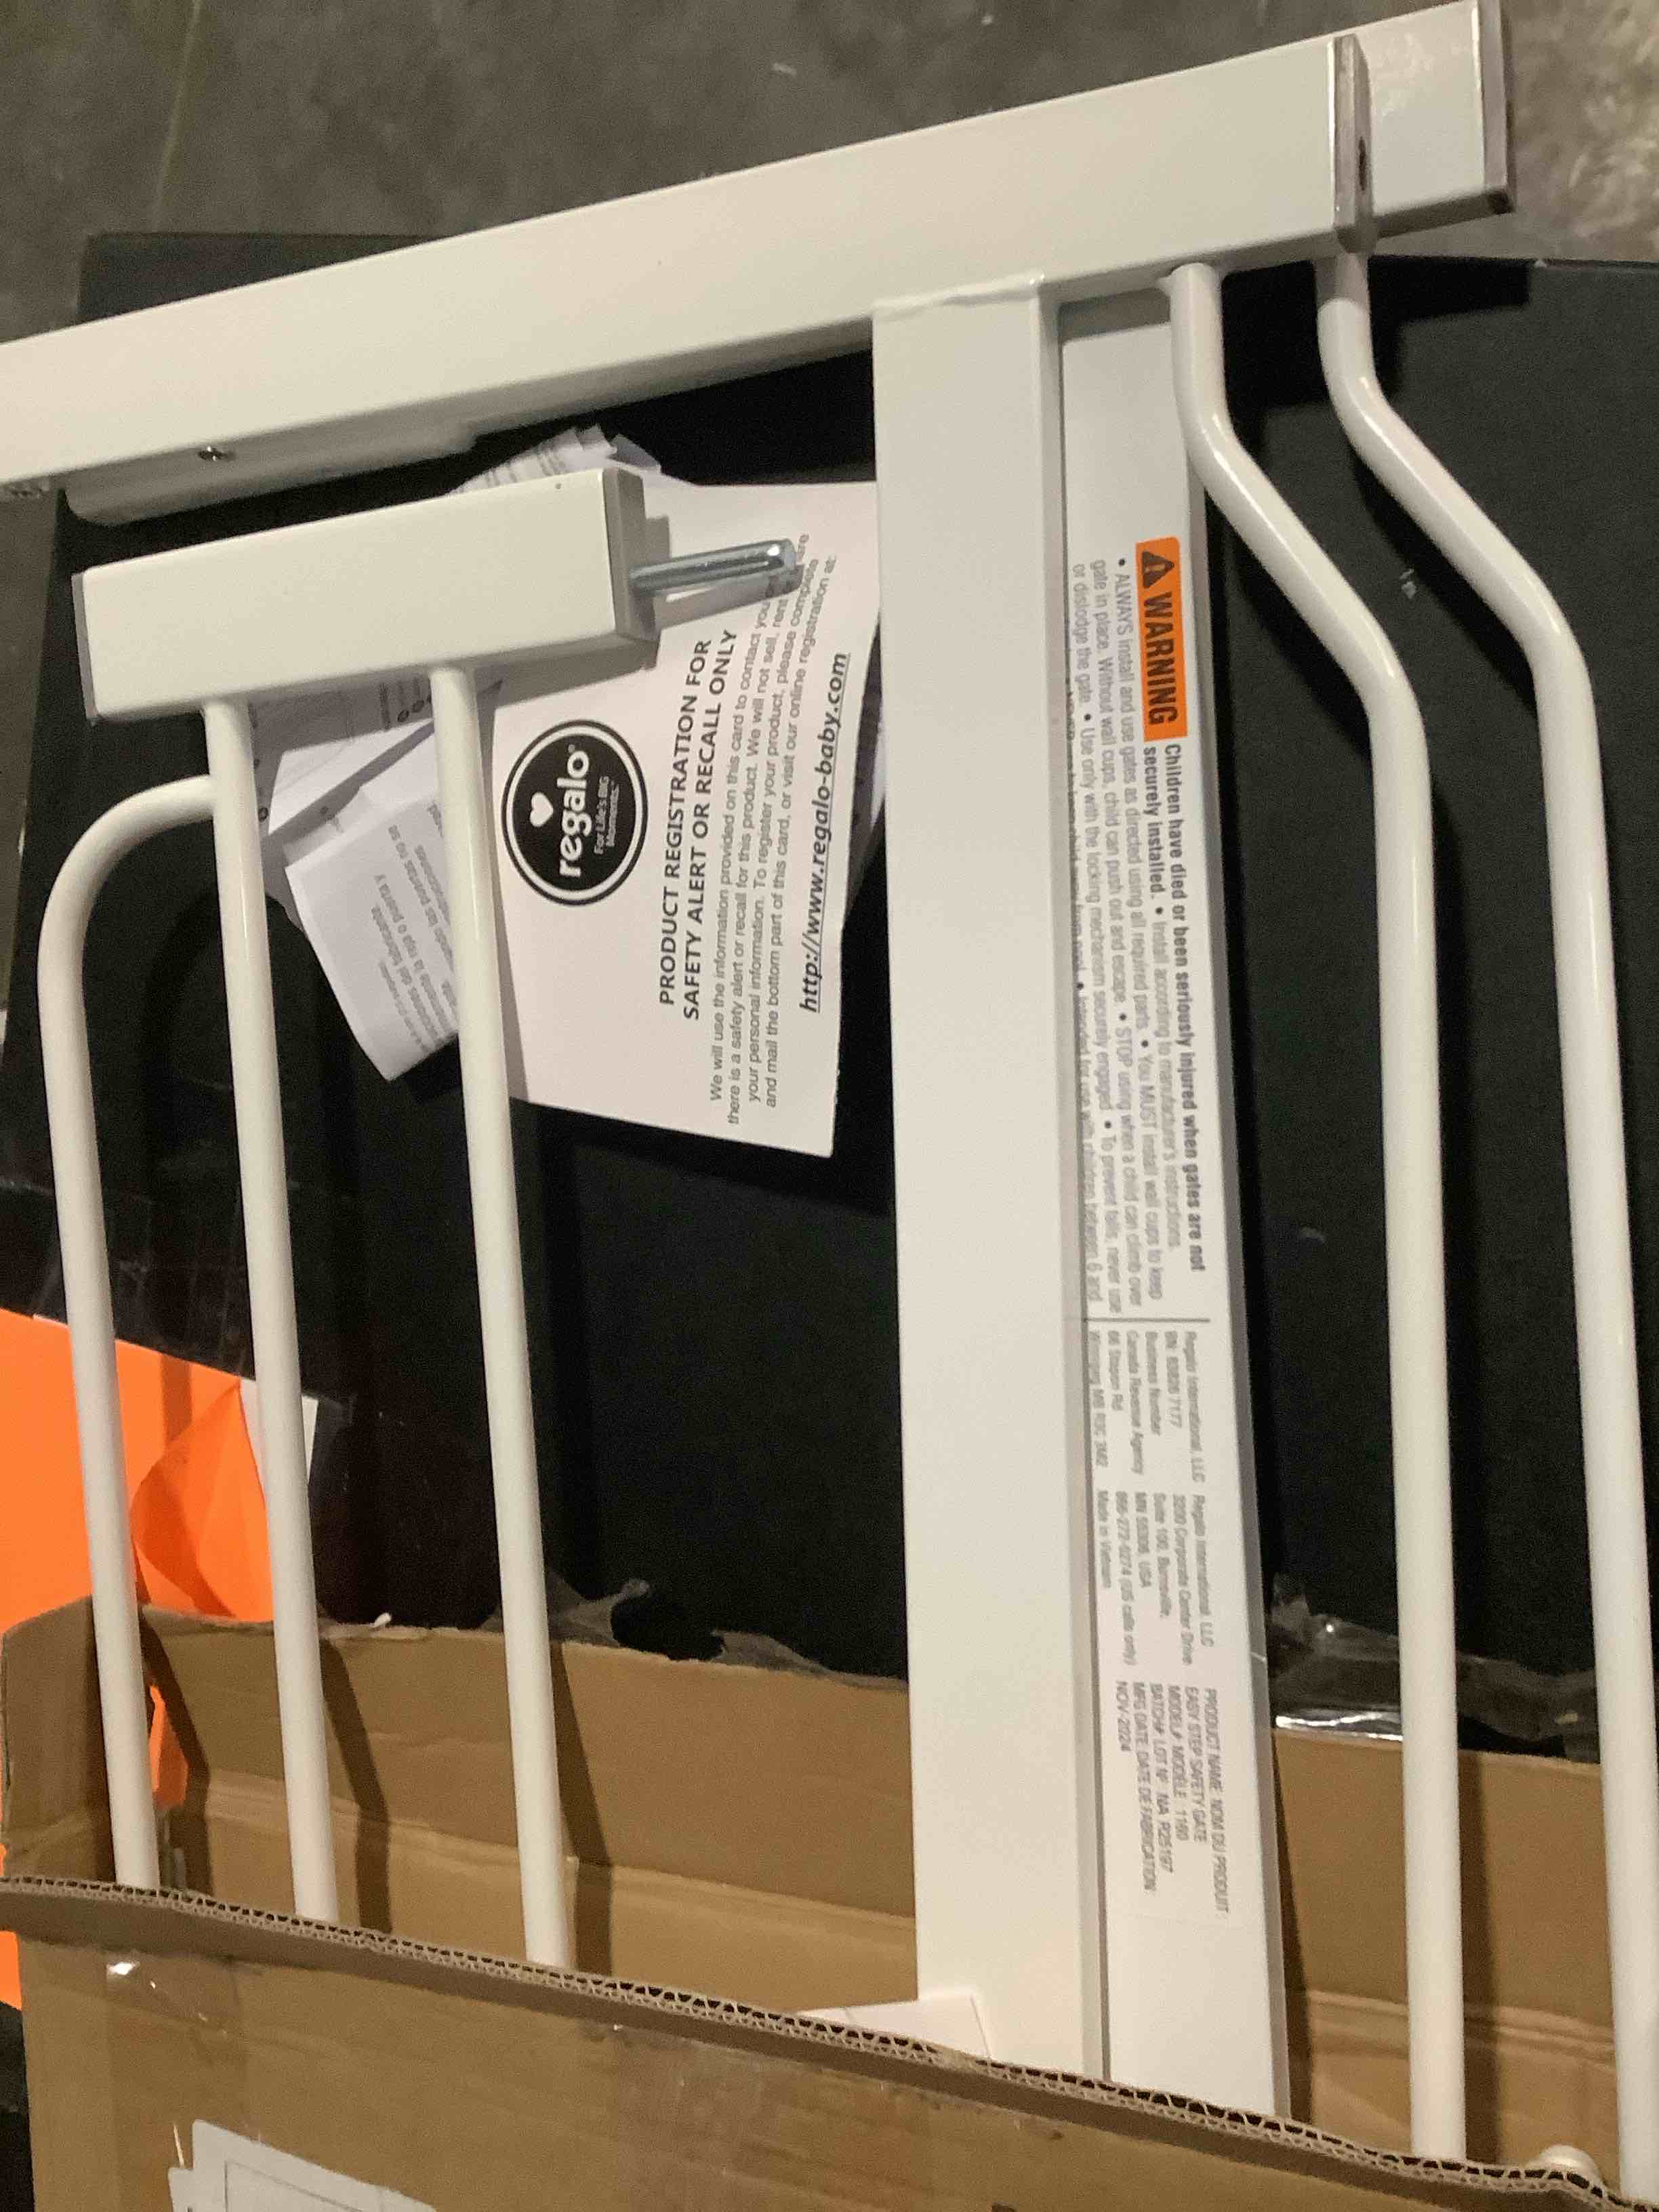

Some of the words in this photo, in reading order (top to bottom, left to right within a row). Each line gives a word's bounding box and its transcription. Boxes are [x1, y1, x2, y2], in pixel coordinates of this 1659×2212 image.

[1072, 564, 1086, 577] or
[1090, 560, 1108, 590] gate
[790, 559, 819, 626] complete
[1095, 594, 1110, 608] in
[1115, 574, 1133, 636] ALWAYS
[755, 600, 773, 629] you
[800, 578, 830, 663] registration
[1072, 583, 1090, 644] dislodge
[686, 640, 712, 686] FOR
[709, 630, 737, 695] ONLY
[740, 633, 761, 690] contact
[777, 630, 796, 683] please
[1076, 647, 1092, 670] the
[1118, 639, 1135, 682] install
[1144, 591, 1178, 724] WARNING
[757, 668, 770, 693] not
[790, 668, 806, 718] online
[1098, 657, 1114, 713] Without
[735, 695, 747, 710] to
[752, 698, 764, 724] will
[1120, 687, 1136, 713] and
[732, 714, 744, 752] card
[747, 729, 761, 756] We
[786, 722, 797, 750] our
[1080, 728, 1096, 755] Use
[1101, 717, 1117, 745] wall
[1121, 716, 1134, 743] use
[695, 703, 721, 794] RECALL
[1120, 746, 1137, 783] gates
[664, 695, 697, 878] REGISTRATION
[726, 755, 740, 784] this
[764, 760, 777, 797] your
[782, 755, 795, 787] visit
[1080, 759, 1098, 789] only
[1143, 747, 1162, 816] securely
[1164, 744, 1182, 814] Children
[726, 789, 736, 811] on
[781, 792, 792, 809] or
[1084, 793, 1099, 823] with
[1104, 792, 1121, 827] child
[1124, 787, 1137, 804] as
[557, 750, 592, 877] regalo
[693, 802, 710, 838] OR
[594, 832, 605, 854] For
[720, 815, 735, 885] provided
[738, 834, 751, 862] this
[758, 802, 773, 863] register
[799, 654, 850, 1014] http://www.regalo-baby.com
[1085, 826, 1101, 848] the
[1105, 831, 1120, 855] can
[1125, 808, 1144, 864] directed
[1168, 819, 1184, 858] have
[735, 867, 748, 888] for
[754, 867, 766, 889] To
[773, 861, 786, 889] this
[1085, 851, 1103, 903] locking
[1105, 859, 1124, 895] push
[1147, 822, 1166, 899] installed.
[687, 846, 706, 924] ALERT
[1126, 868, 1144, 907] using
[1171, 864, 1187, 899] died
[735, 893, 746, 936] recall
[771, 893, 783, 909] of
[1109, 899, 1124, 920] out
[1172, 905, 1185, 921] or
[713, 889, 729, 979] information
[771, 914, 783, 946] part
[1130, 911, 1147, 928] all
[659, 886, 678, 1005] PRODUCT
[735, 939, 744, 958] or
[749, 897, 764, 989] information.
[1110, 926, 1126, 950] and
[1173, 927, 1189, 966] been
[683, 930, 701, 1020] SAFETY
[731, 962, 743, 997] alert
[766, 951, 779, 1006] bottom
[713, 983, 725, 1008] the
[1154, 968, 1172, 1038] according
[1175, 972, 1195, 1047] seriously
[714, 1012, 724, 1041] use
[729, 1001, 745, 1049] safety
[748, 994, 762, 1063] personal
[766, 1010, 778, 1036] the
[712, 1045, 722, 1070] will
[731, 1054, 741, 1064] a
[766, 1040, 778, 1073] mail
[1115, 1027, 1133, 1068] STOP
[1158, 1041, 1172, 1056] to
[729, 1068, 741, 1081] is
[748, 1067, 760, 1102] your
[1138, 1054, 1155, 1082] You
[1177, 1052, 1197, 1110] injured
[710, 1075, 722, 1101] We
[727, 1085, 740, 1124] there
[764, 1078, 777, 1107] and
[1116, 1071, 1134, 1111] using
[1140, 1085, 1158, 1129] MUST
[1121, 1114, 1136, 1151] when
[1183, 1115, 1199, 1159] when
[1122, 1155, 1135, 1163] a
[1182, 1164, 1201, 1208] gates
[1124, 1205, 1139, 1230] can
[1187, 1213, 1201, 1239] are
[1190, 1245, 1206, 1271] not
